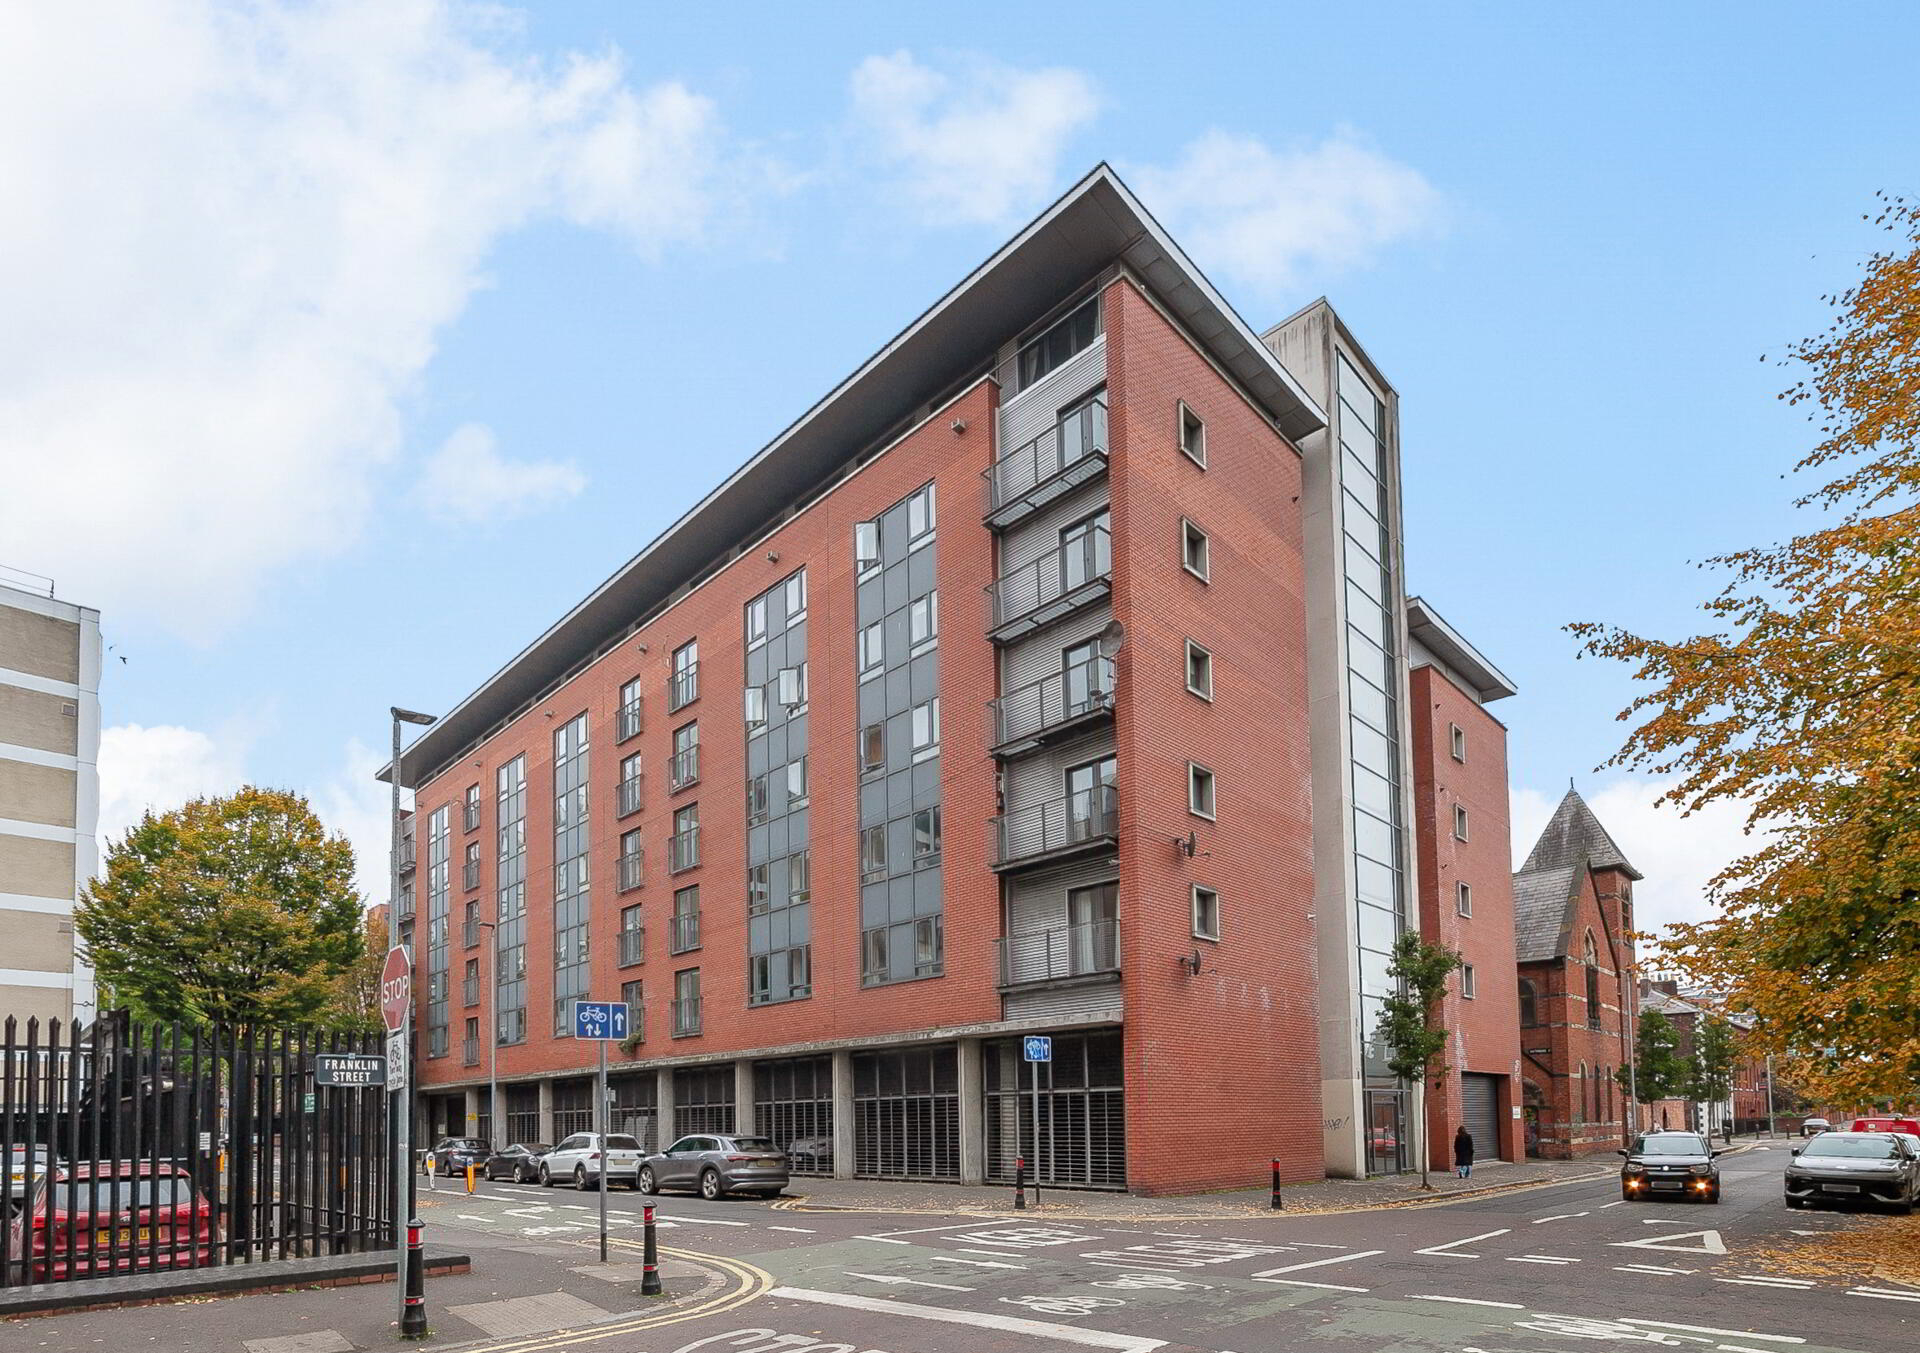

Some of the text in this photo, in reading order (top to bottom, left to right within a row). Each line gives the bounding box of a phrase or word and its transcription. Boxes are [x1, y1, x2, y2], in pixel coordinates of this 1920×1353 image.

[383, 975, 408, 1003] STOP
[325, 1060, 378, 1070] FRANKLIN
[333, 1072, 371, 1082] STREET
[939, 1228, 1105, 1249] KEEP
[1078, 1240, 1298, 1267] CLEAR
